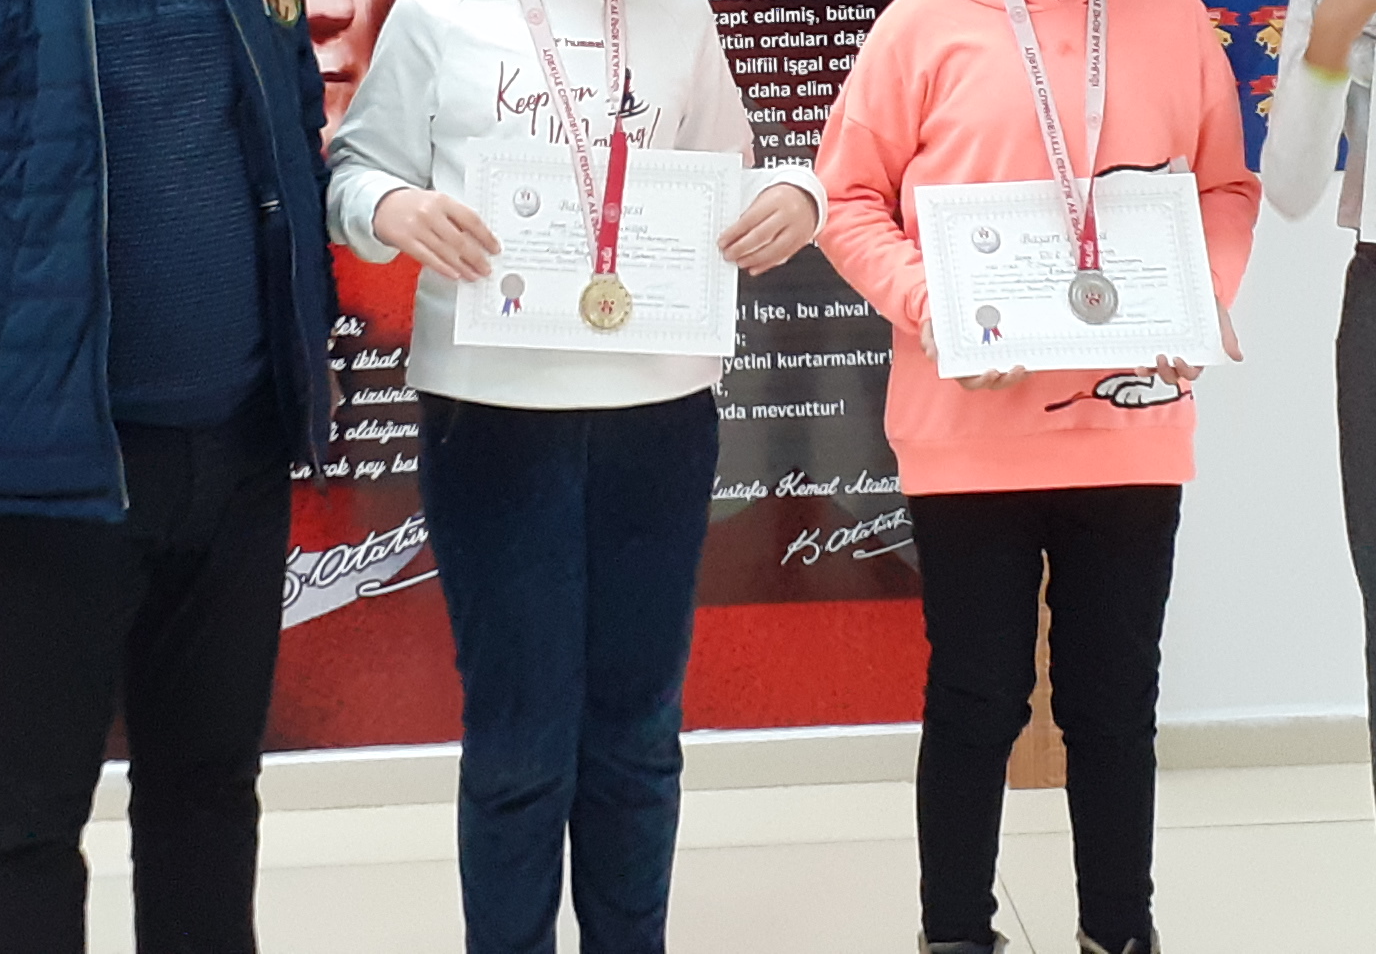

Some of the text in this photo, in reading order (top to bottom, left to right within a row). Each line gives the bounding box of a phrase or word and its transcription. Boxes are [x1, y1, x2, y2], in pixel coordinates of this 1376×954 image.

[752, 4, 876, 26] edilmiş, bütün
[759, 31, 827, 48] orduları
[735, 54, 823, 75] bilfiil işgal
[496, 60, 550, 137] Keep
[747, 79, 832, 98] daha elim
[759, 134, 779, 147] ve
[753, 299, 870, 323] İşte, bu ahval
[777, 348, 894, 370] kurtarmaktır!
[751, 398, 844, 418] mevcuttur!
[775, 470, 841, 498] Kemal
